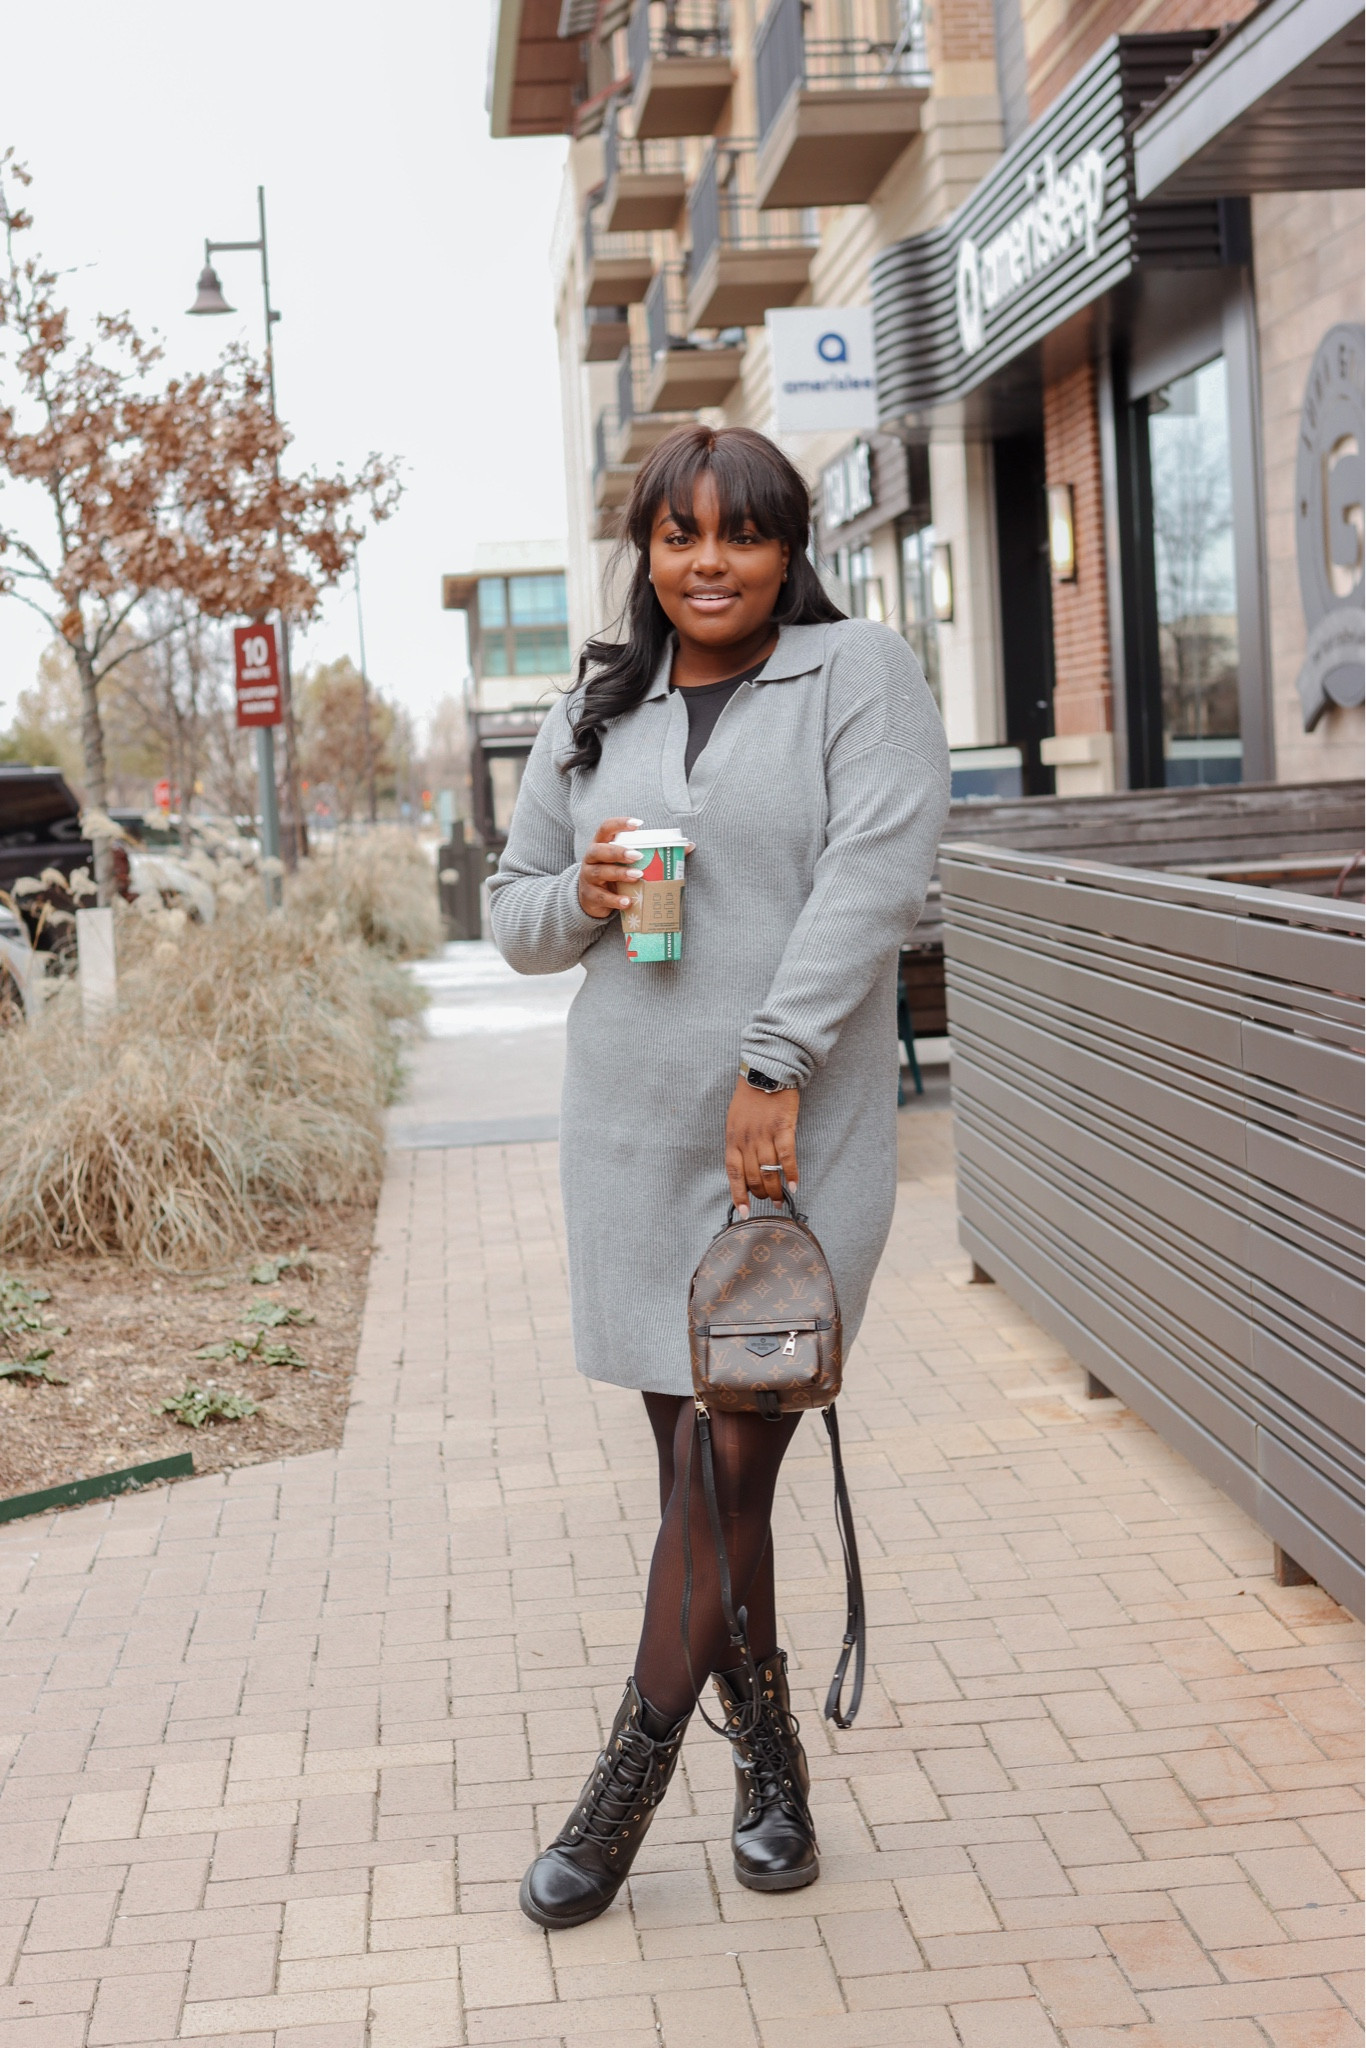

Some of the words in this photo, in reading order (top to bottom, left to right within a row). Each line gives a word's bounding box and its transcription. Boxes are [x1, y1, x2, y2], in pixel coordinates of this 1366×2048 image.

[981, 149, 1105, 308] amerisleep
[783, 371, 874, 394] amerislee
[241, 635, 269, 667] 10
